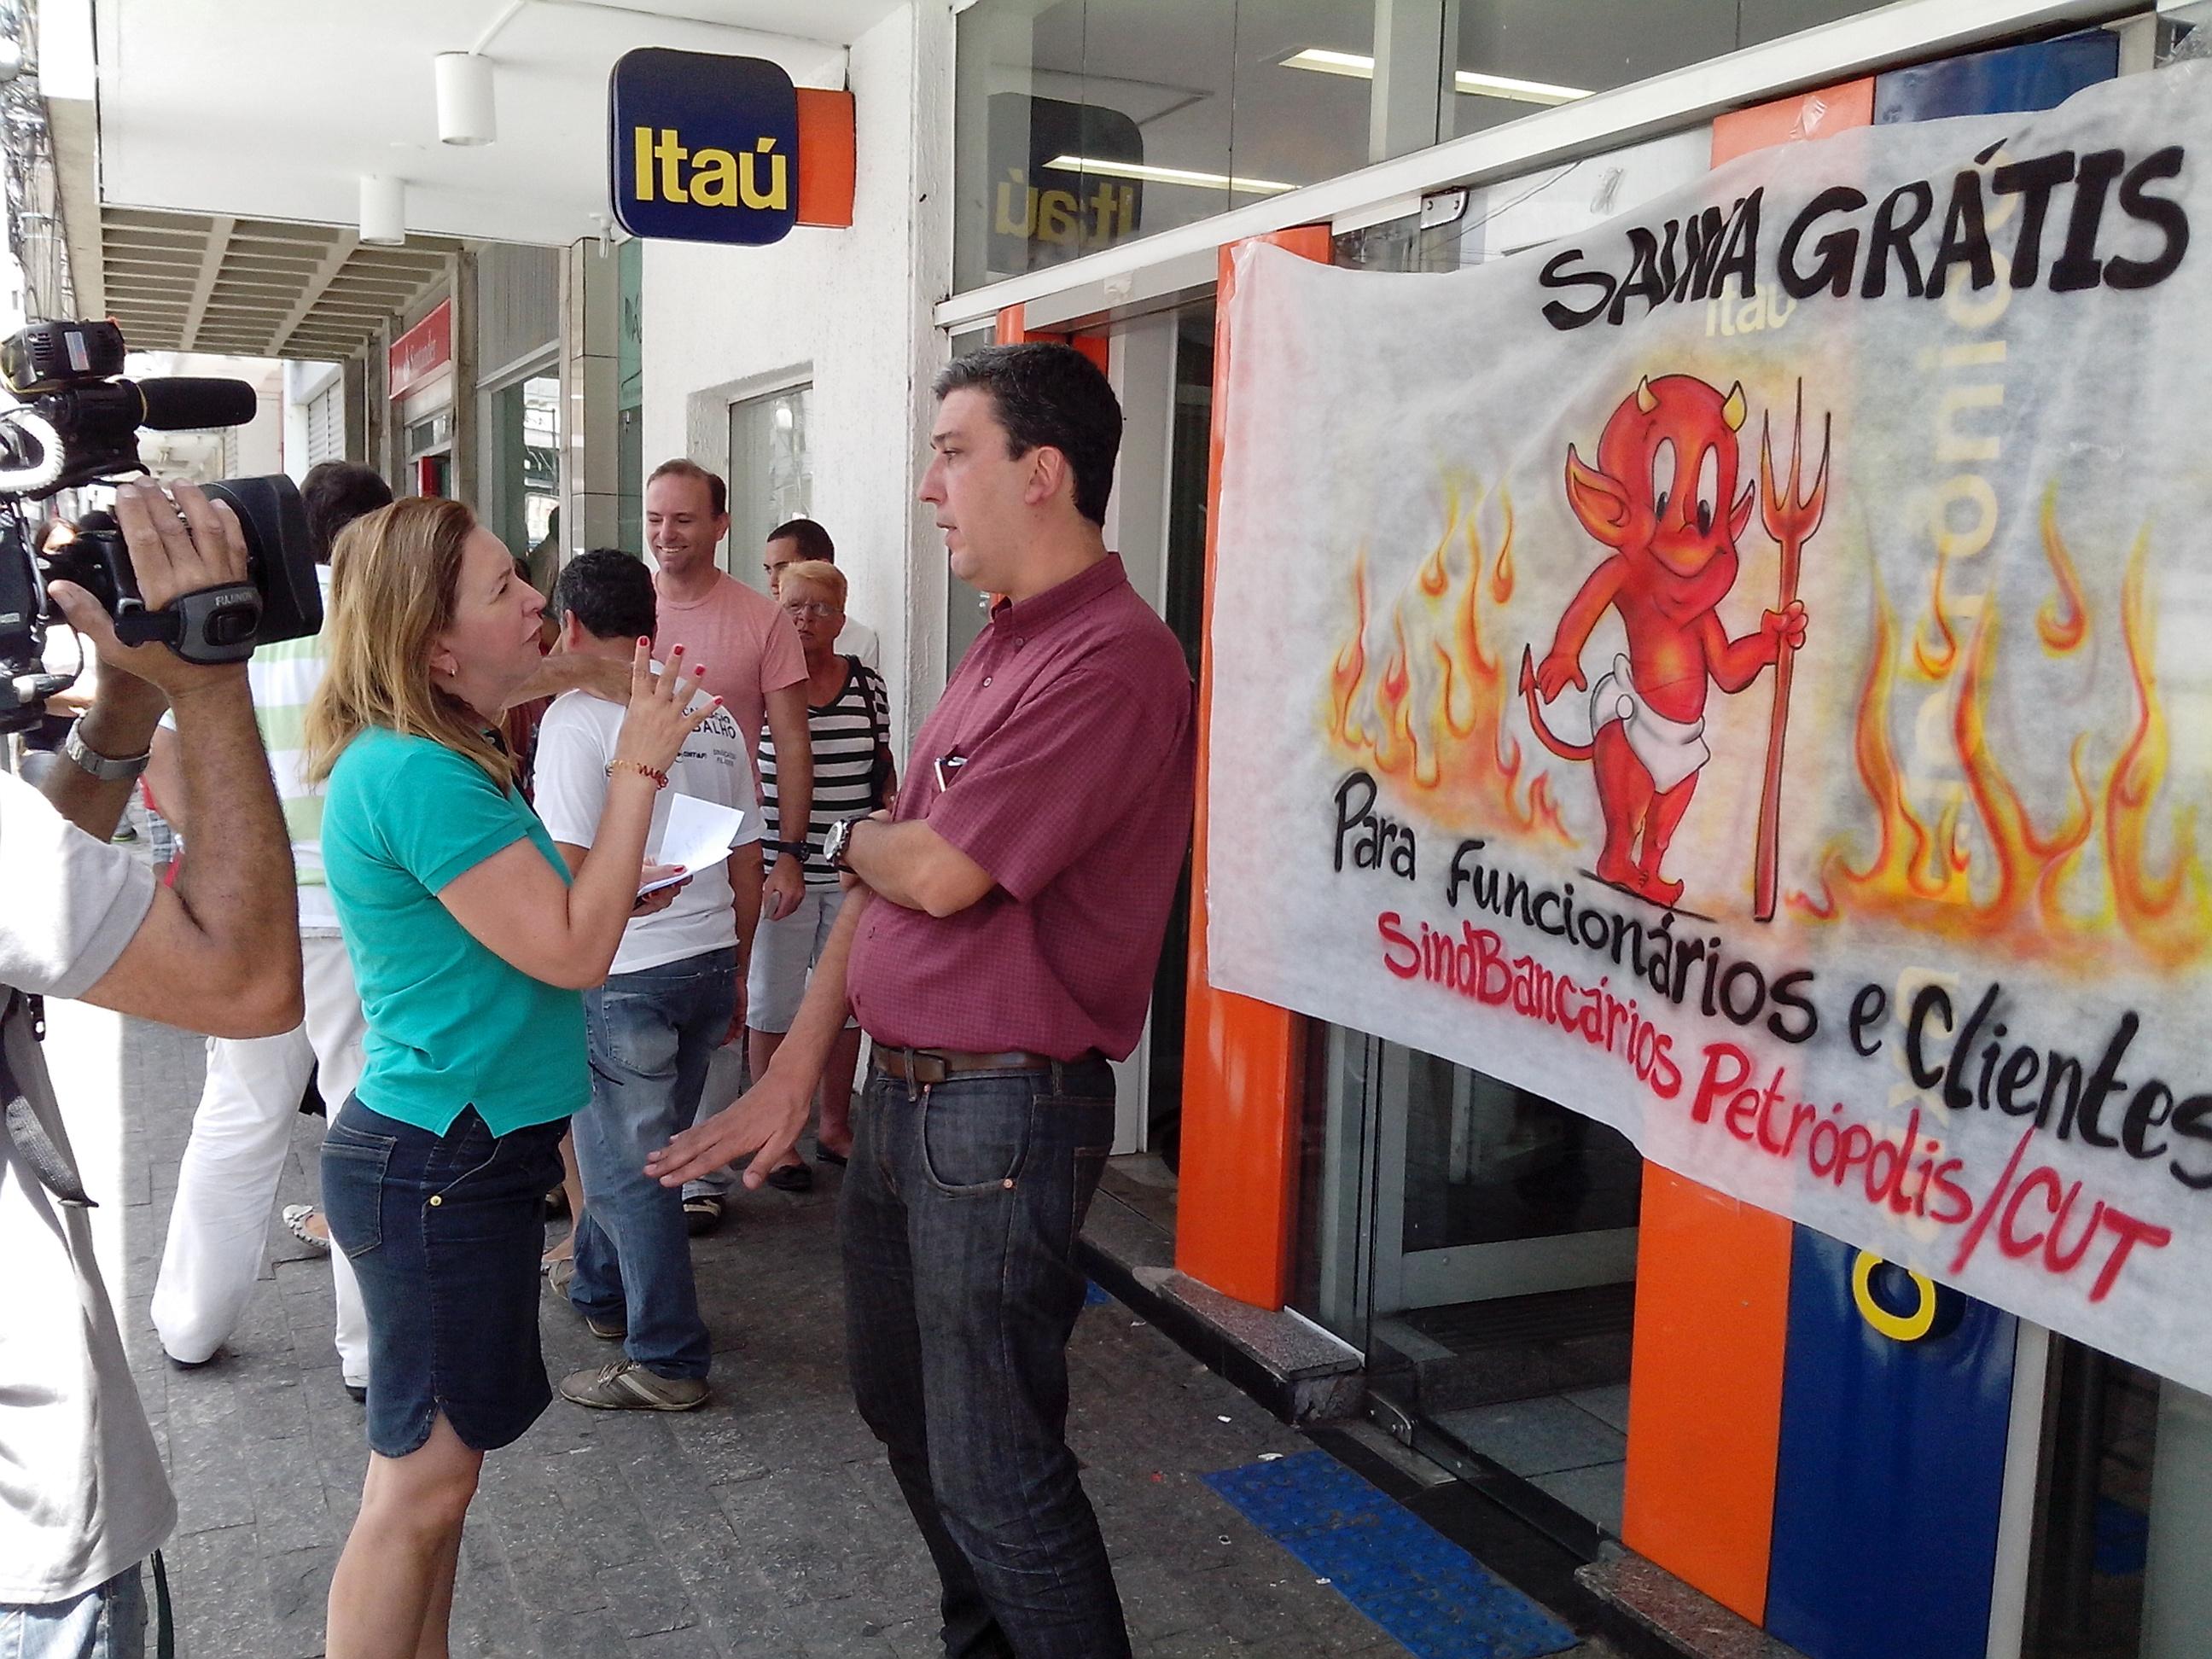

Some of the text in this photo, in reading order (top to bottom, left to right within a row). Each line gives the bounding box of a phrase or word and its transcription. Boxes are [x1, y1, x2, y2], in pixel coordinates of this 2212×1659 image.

[635, 125, 788, 211] Itaú
[1539, 137, 2190, 331] SAUNA GRÁTIS
[1334, 771, 2212, 1190] Para Funcionários e Clientes
[1377, 910, 1682, 1099] SindBancários
